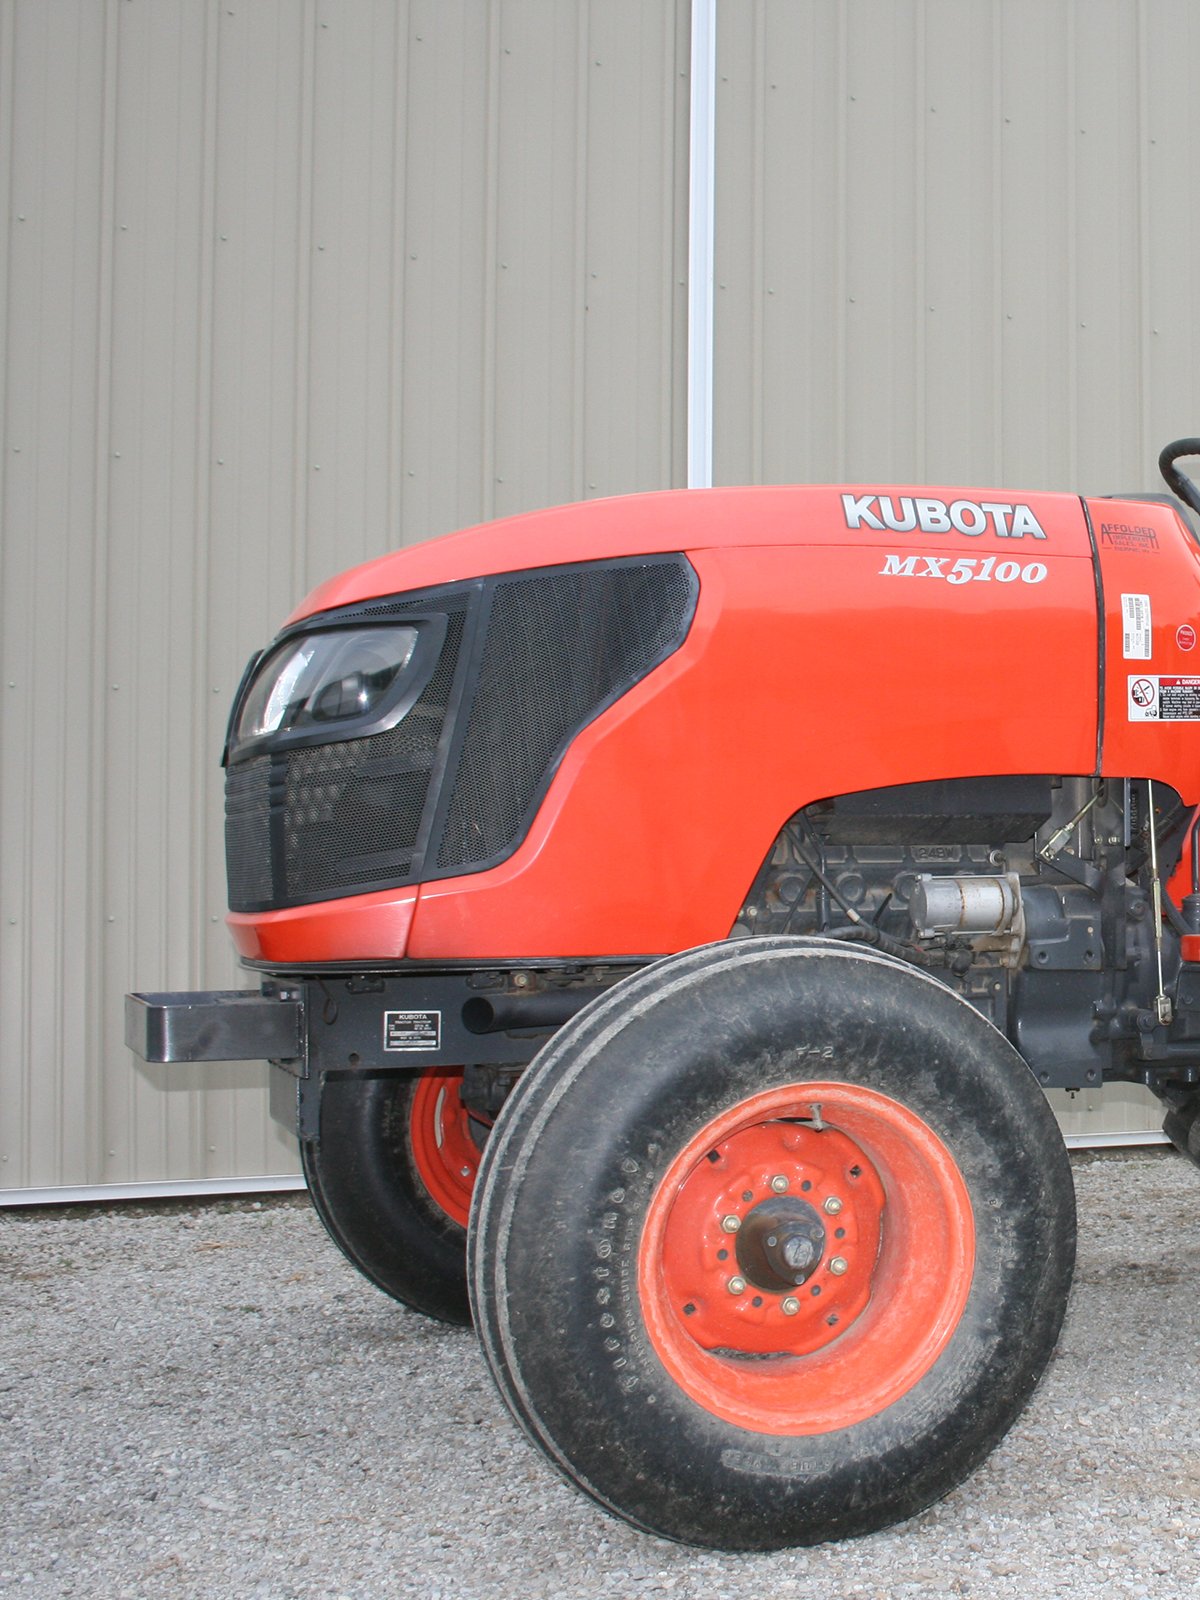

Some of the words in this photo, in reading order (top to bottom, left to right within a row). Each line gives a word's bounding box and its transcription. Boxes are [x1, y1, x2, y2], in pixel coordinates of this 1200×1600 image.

[842, 494, 1047, 539] KUBOTA
[1101, 522, 1159, 550] AFFOLDER
[878, 554, 1048, 585] MX5100
[795, 1045, 834, 1059] F-2
